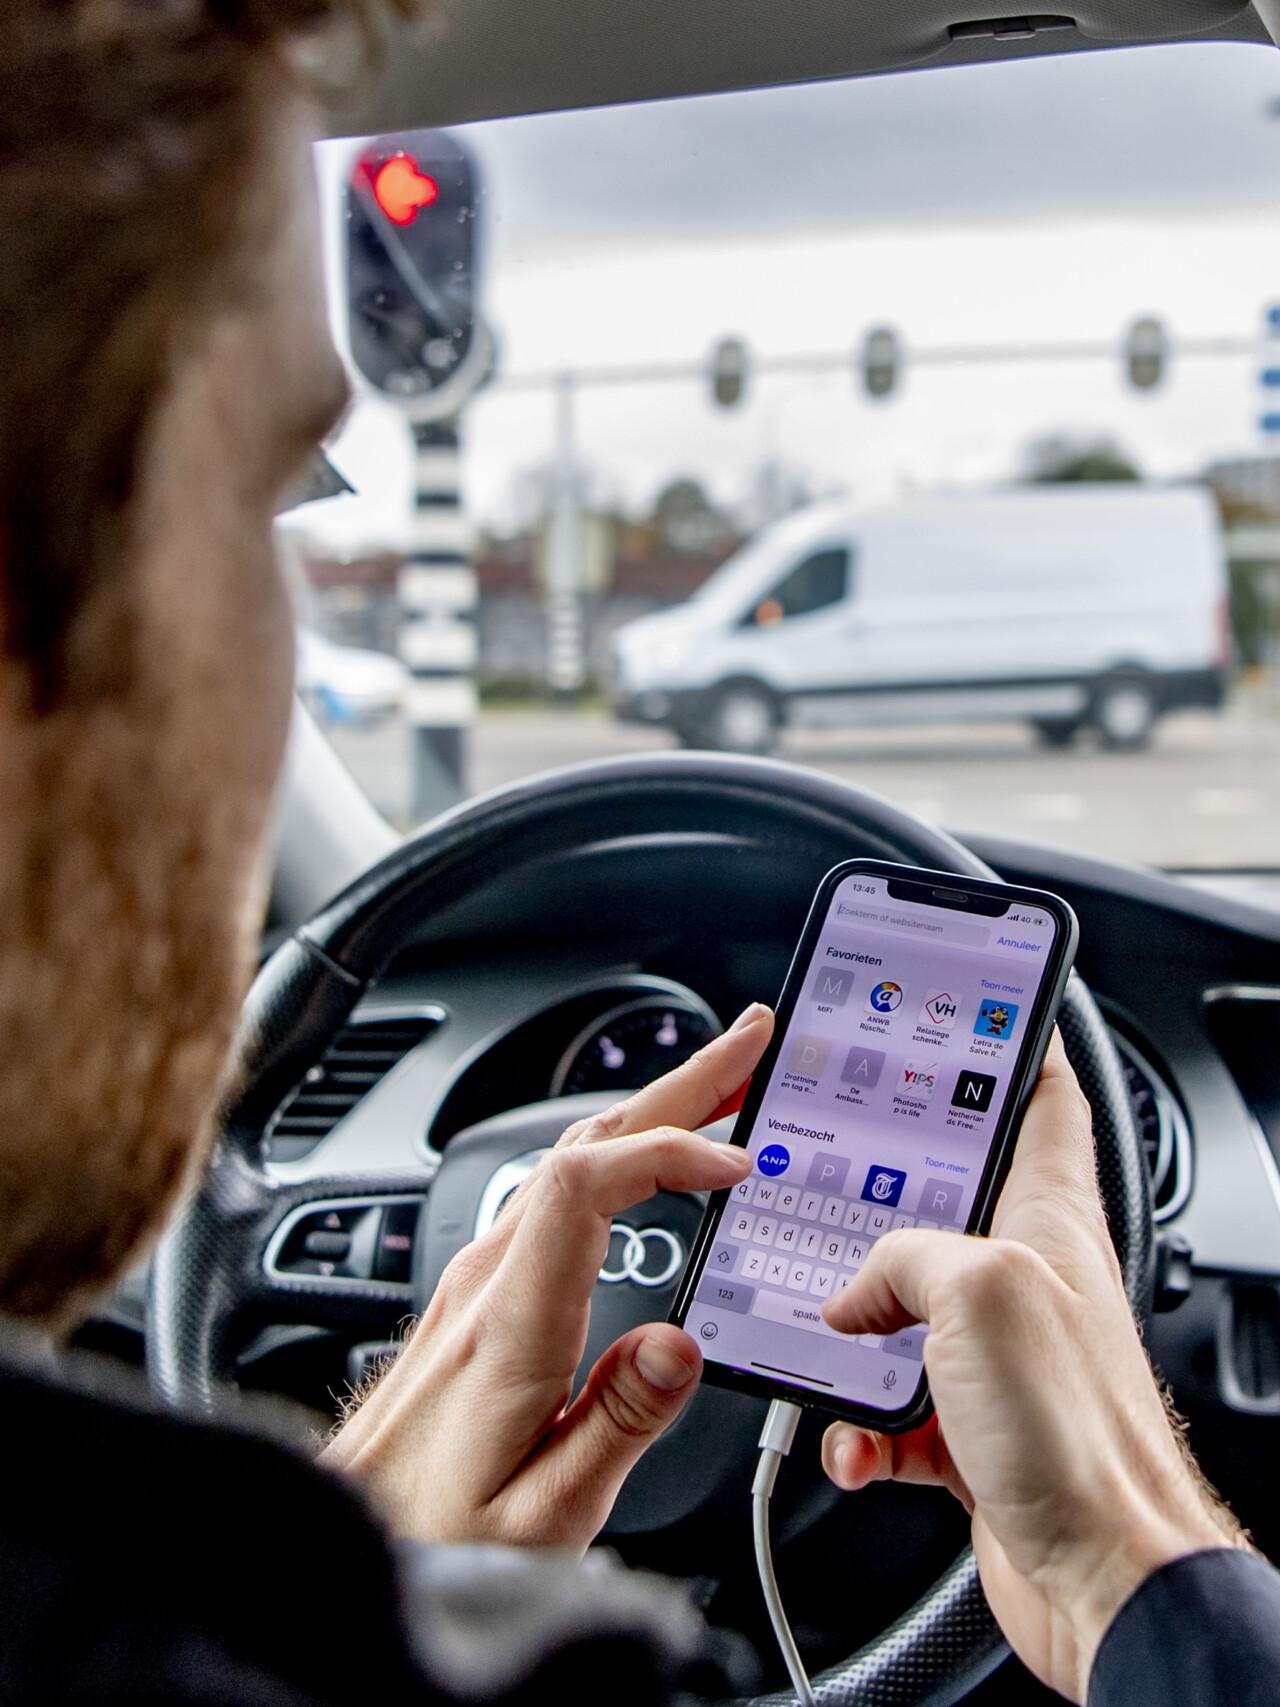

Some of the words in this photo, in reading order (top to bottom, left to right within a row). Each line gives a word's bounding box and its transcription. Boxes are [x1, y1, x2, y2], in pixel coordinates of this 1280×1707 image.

[853, 884, 876, 895] 13:45
[840, 906, 878, 920] Zoekterm
[890, 917, 944, 933] websitenaam
[997, 936, 1042, 952] Annuleer
[826, 946, 883, 966] Favorieten
[822, 977, 843, 996] M
[980, 979, 1000, 990] Toon
[1002, 985, 1025, 995] meer
[935, 1001, 956, 1017] VH
[867, 1016, 890, 1026] ANWB
[916, 1026, 950, 1039] Relatiege
[969, 1046, 989, 1056] Salve
[973, 1038, 992, 1048] Letra
[854, 1058, 868, 1077] A
[784, 1072, 818, 1087] Drottning
[791, 1084, 803, 1092] tog
[850, 1087, 860, 1095] De
[964, 1081, 983, 1102] N
[892, 1097, 927, 1110] Photosho
[908, 1110, 920, 1118] life
[948, 1109, 984, 1123] Netherlan
[768, 1118, 835, 1143] Veelbezocht
[760, 1154, 788, 1166] ANP
[924, 1156, 945, 1169] Toon
[947, 1162, 970, 1175] meer
[821, 1164, 835, 1181] P
[932, 1191, 948, 1211] R
[718, 1288, 735, 1300] 123
[792, 1308, 821, 1322] spatie
